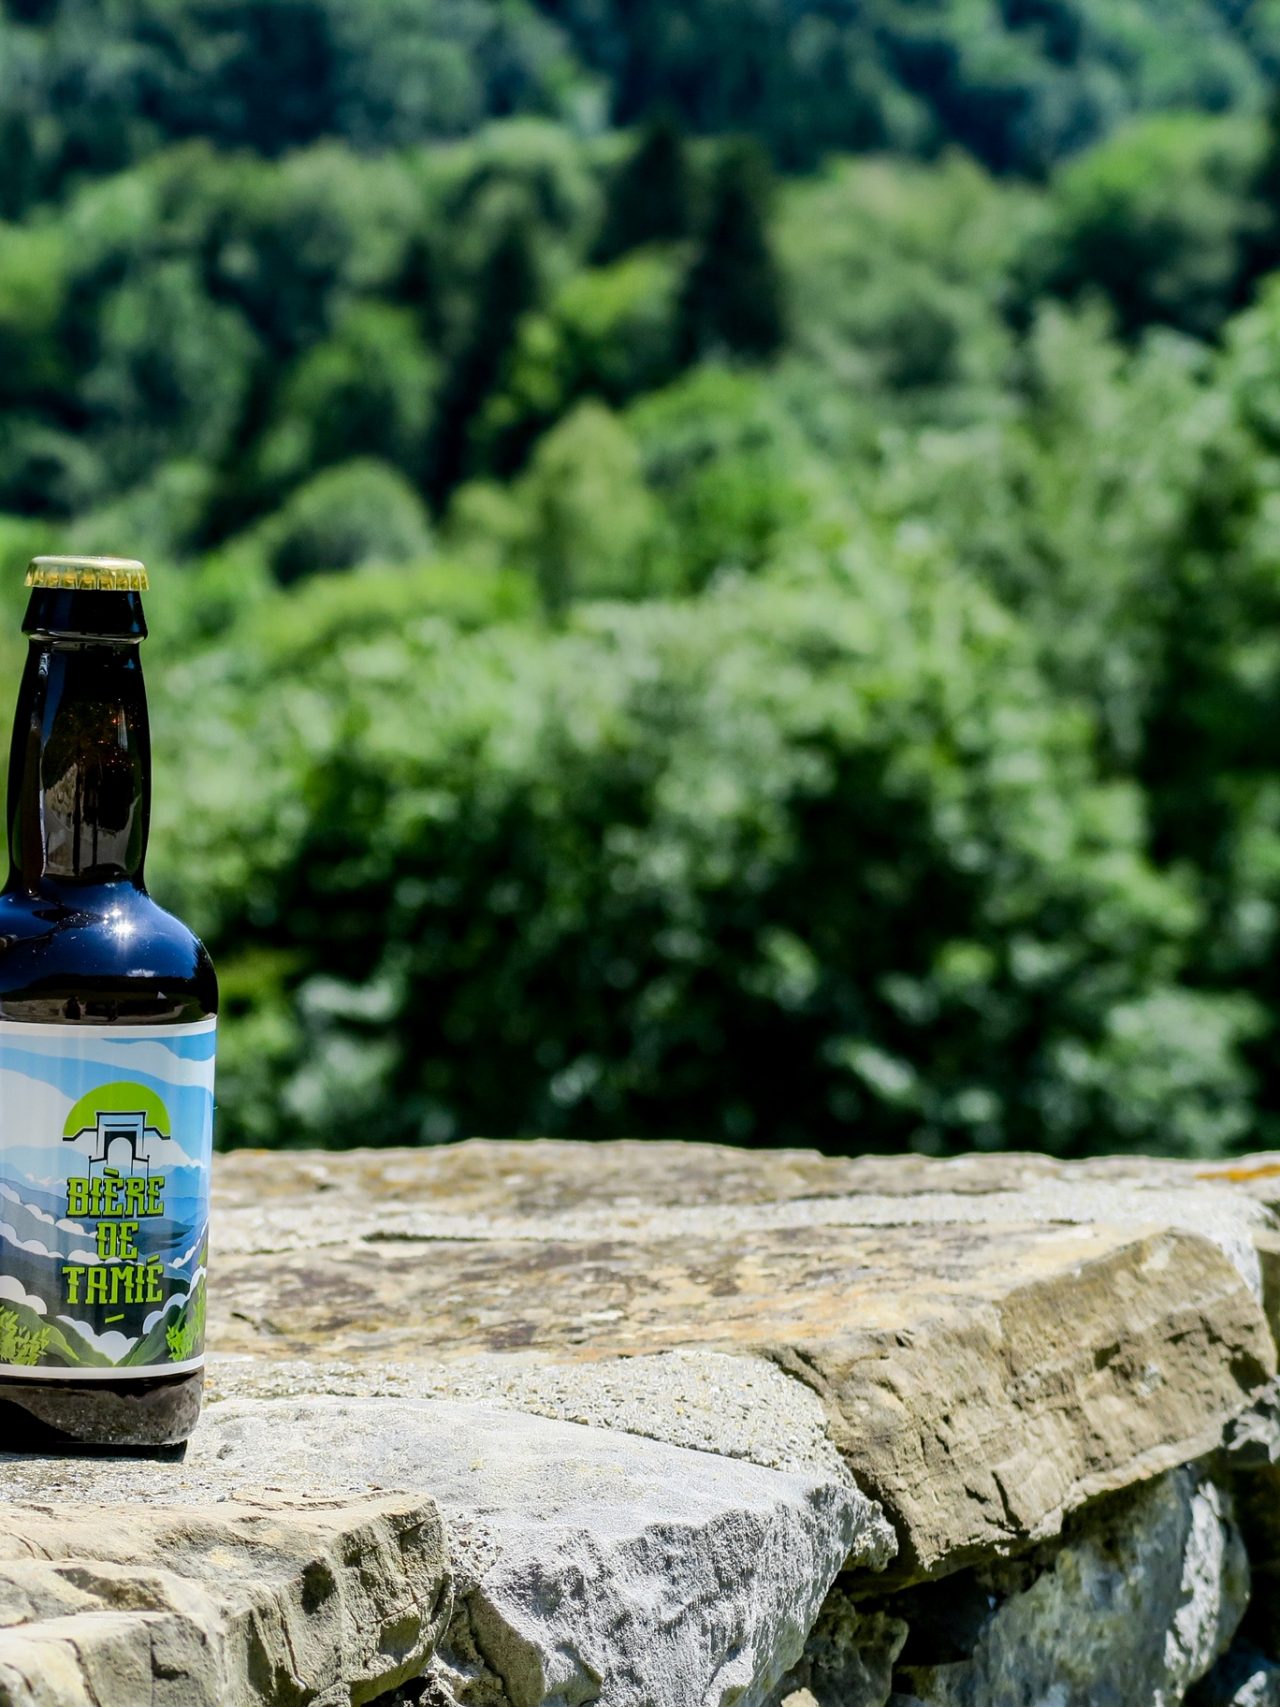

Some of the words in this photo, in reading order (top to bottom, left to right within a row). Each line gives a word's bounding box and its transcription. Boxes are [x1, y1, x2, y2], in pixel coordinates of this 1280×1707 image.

[65, 1166, 166, 1218] BIÈRE
[95, 1220, 140, 1261] DE
[61, 1253, 166, 1305] TAMIÉ
